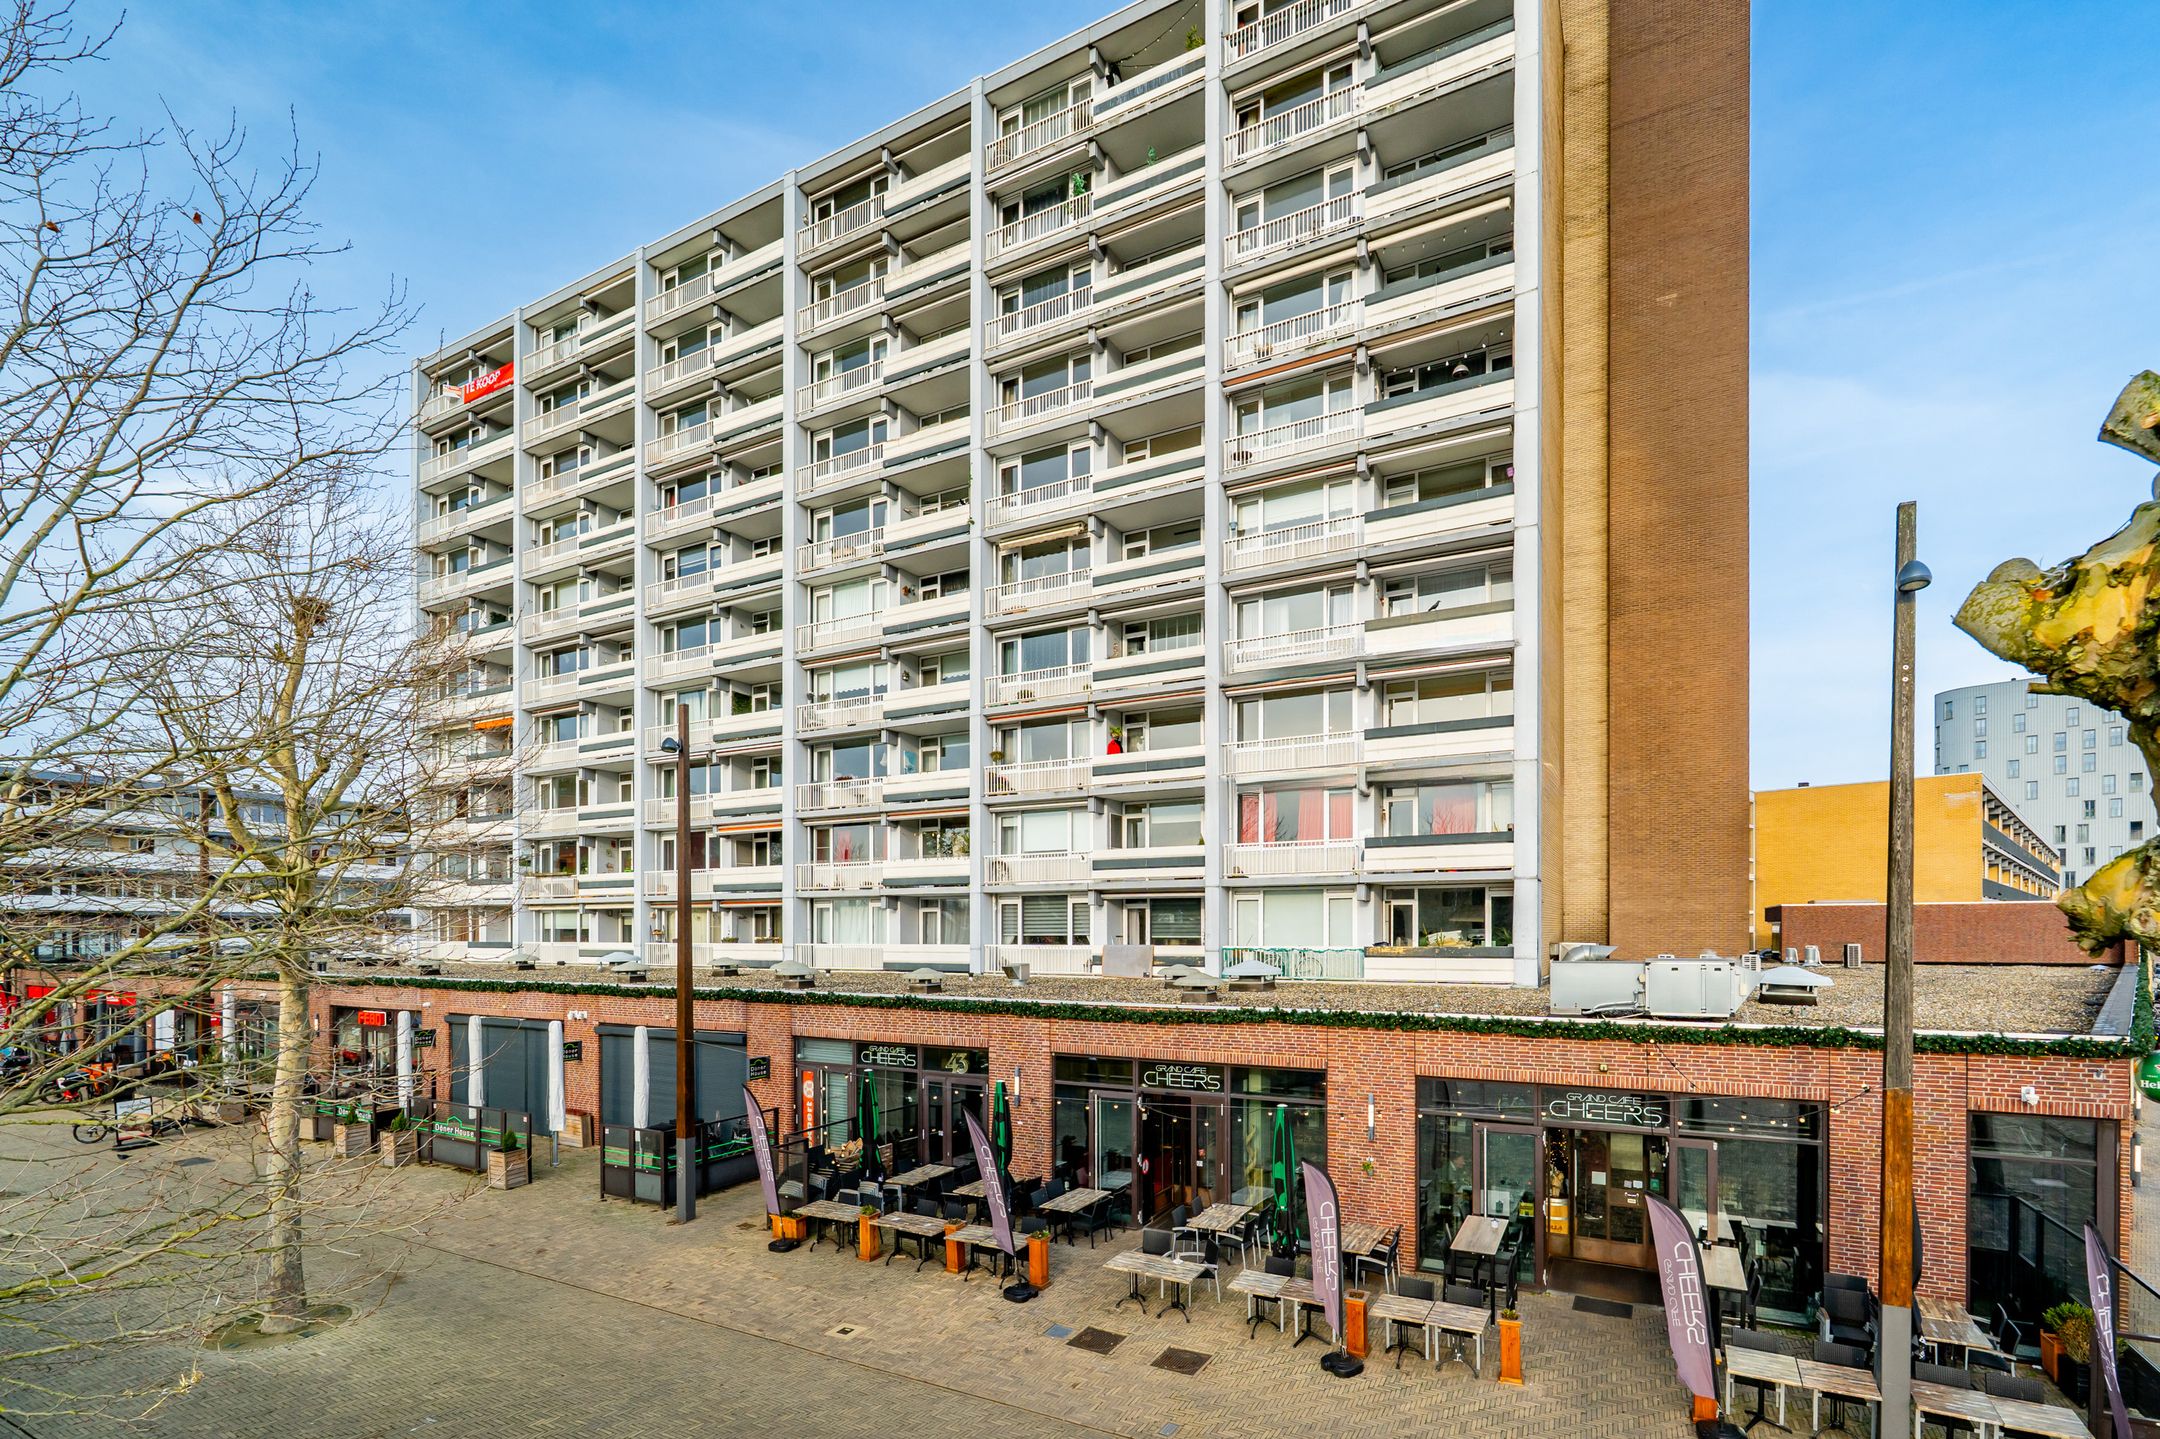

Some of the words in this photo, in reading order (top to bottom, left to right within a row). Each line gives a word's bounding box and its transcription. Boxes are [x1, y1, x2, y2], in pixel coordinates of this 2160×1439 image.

[466, 382, 475, 394] TE
[475, 370, 501, 390] KOOP
[869, 1045, 889, 1053] GRAND
[860, 1050, 916, 1067] CHEERS
[945, 1052, 969, 1074] 43
[1155, 1064, 1183, 1073] GRAND
[1184, 1066, 1207, 1075] CAFE
[1143, 1071, 1221, 1089] CHEERS
[1566, 1092, 1607, 1103] GRAND
[1608, 1095, 1642, 1105] CAFE
[1549, 1100, 1662, 1124] CHEERS
[454, 1127, 474, 1137] House
